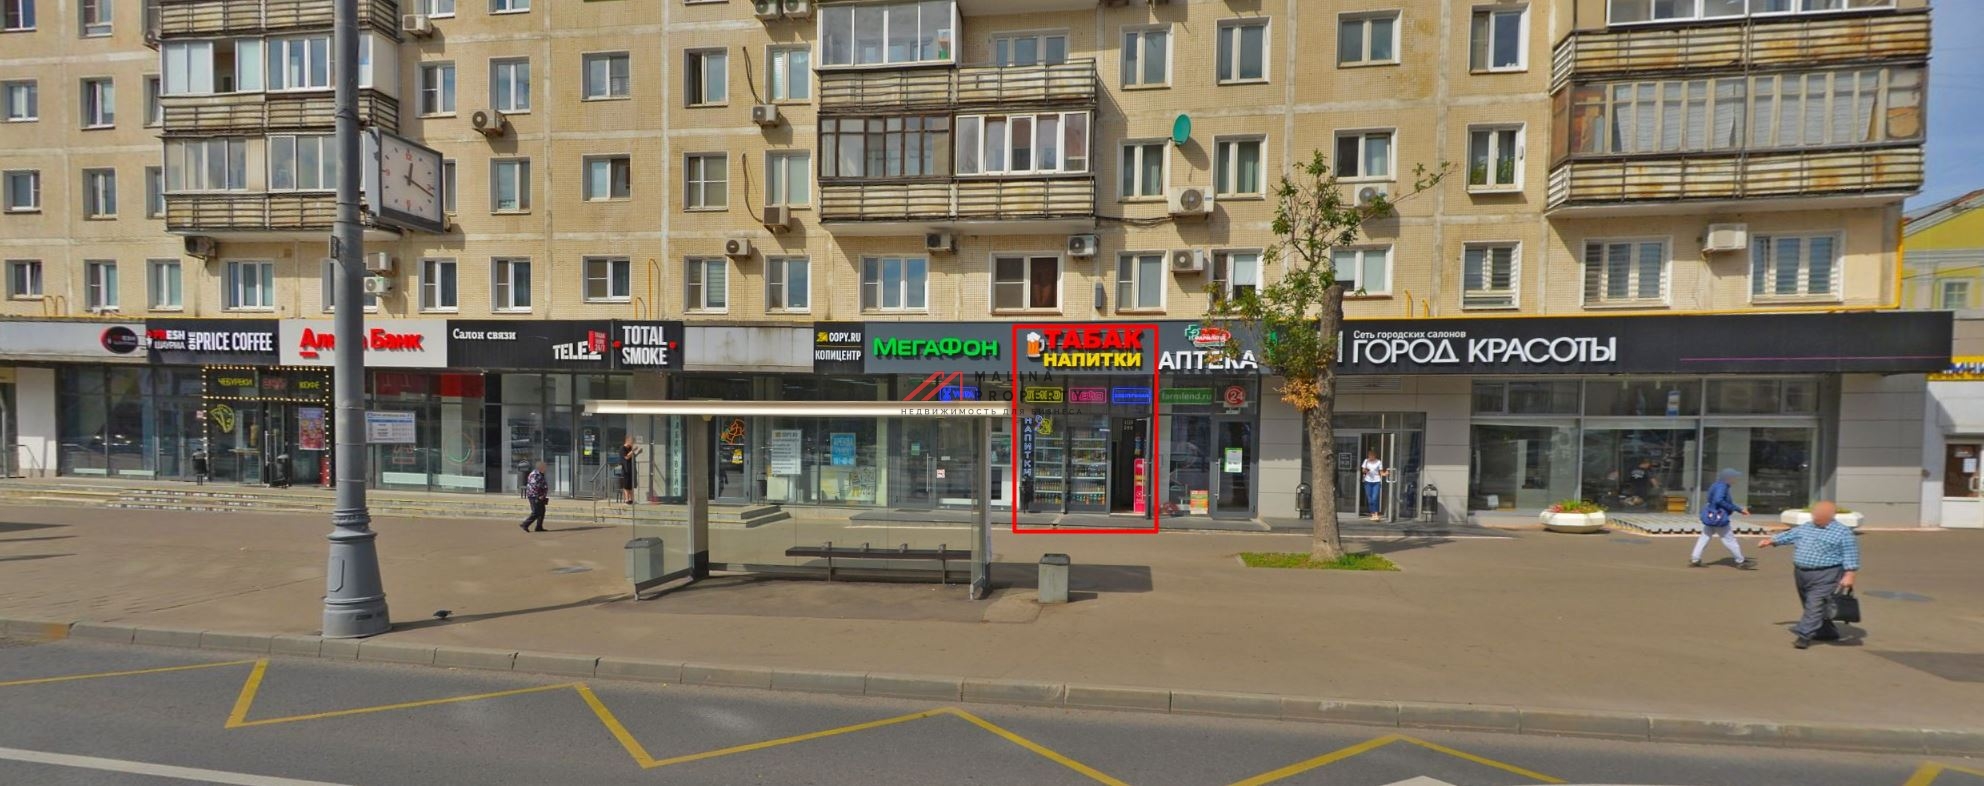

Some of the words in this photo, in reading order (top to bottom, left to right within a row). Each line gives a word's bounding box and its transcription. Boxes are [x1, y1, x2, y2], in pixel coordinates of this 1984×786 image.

[188, 332, 197, 350] ONE
[197, 332, 228, 351] PRICE
[232, 332, 273, 351] COFFEE
[370, 328, 424, 350] Банк
[453, 328, 484, 340] Салон
[487, 331, 517, 340] связи
[622, 325, 667, 346] TOTAL
[829, 332, 861, 343] COPY.RU
[1043, 329, 1142, 349] ТАБАК
[1353, 330, 1375, 339] Сеть
[1377, 331, 1425, 340] городских
[1427, 331, 1467, 339] салонов
[622, 347, 667, 365] SMOKE
[815, 350, 861, 362] КОПИЦЕНТР
[1043, 352, 1141, 367] НАПИТКИ
[1158, 350, 1258, 370] АПТЕКА
[1353, 338, 1460, 364] ГОРОД
[1468, 337, 1617, 364] КРАСОТЫ
[1024, 417, 1032, 477] НАПИТКИ
